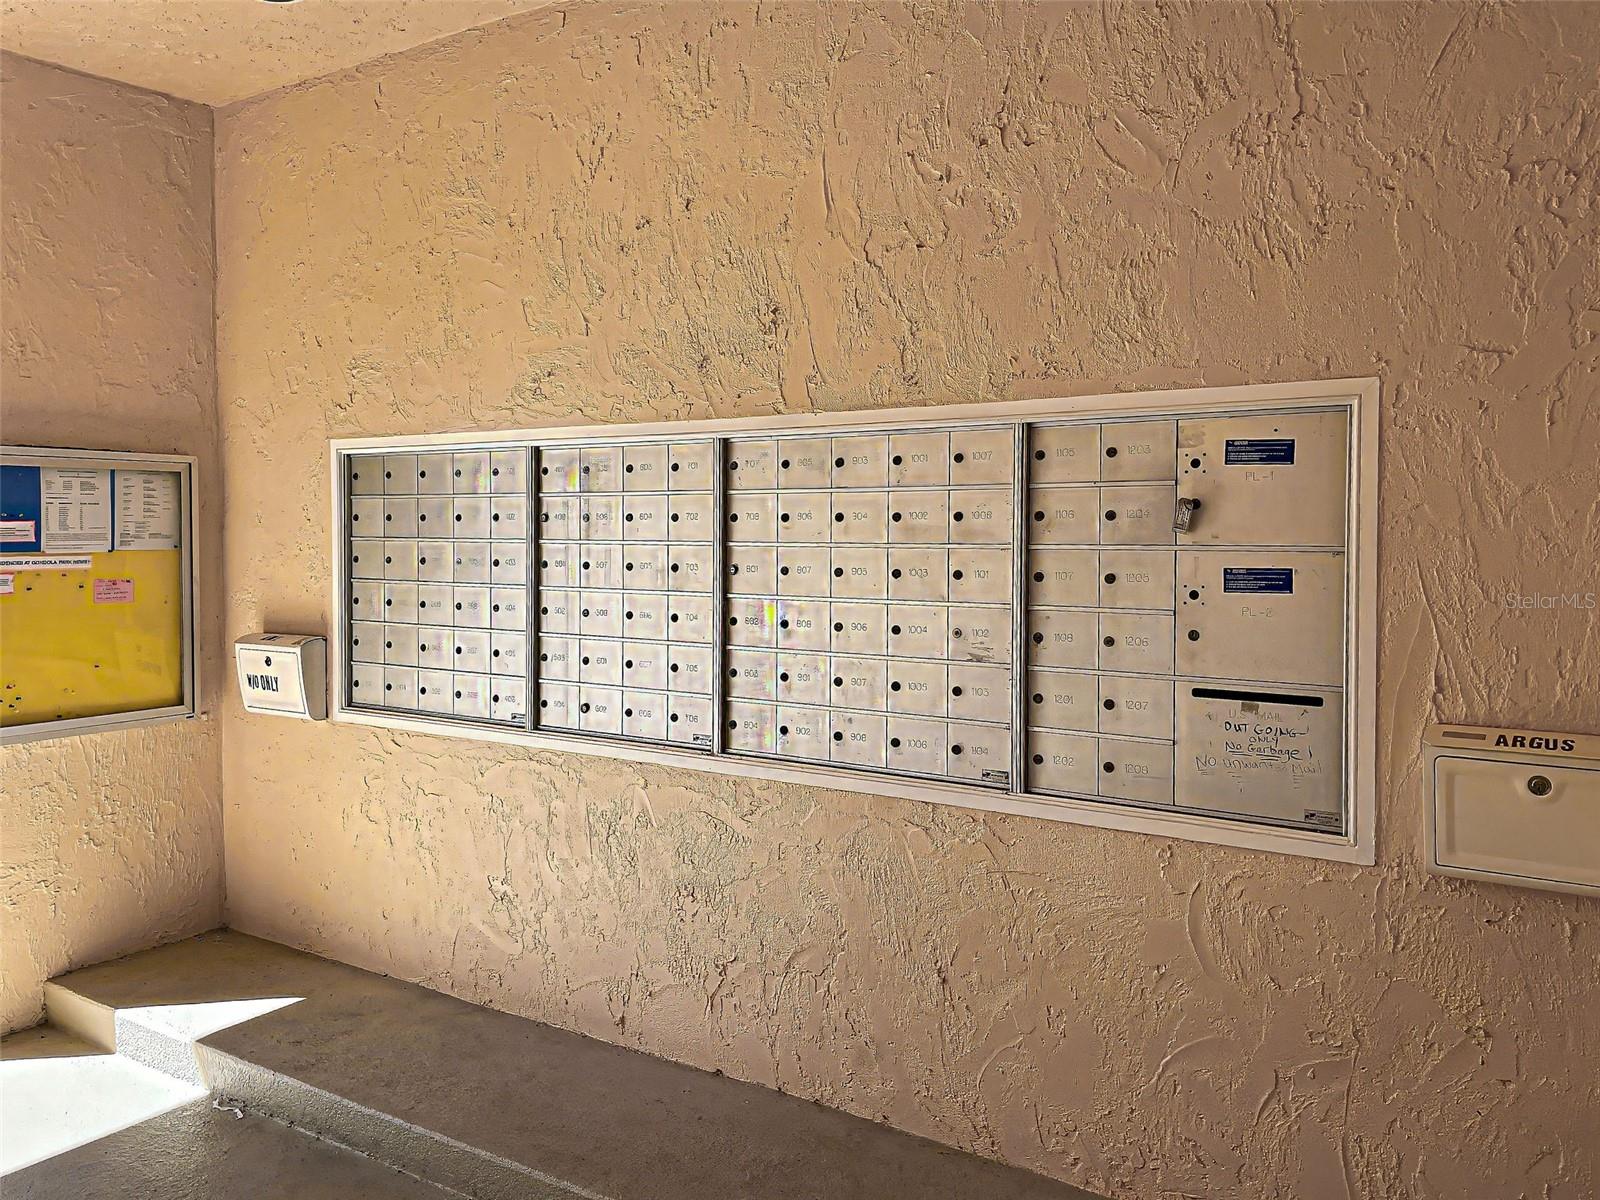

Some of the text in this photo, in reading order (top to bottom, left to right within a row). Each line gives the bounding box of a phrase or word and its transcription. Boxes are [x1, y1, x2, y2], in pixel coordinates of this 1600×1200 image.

[1056, 448, 1075, 457] 1105
[1128, 445, 1151, 454] 1203
[852, 456, 868, 464] 903
[911, 454, 928, 462] 1001
[972, 451, 992, 460] 1007
[1245, 471, 1275, 482] PL-1
[686, 512, 698, 520] 702
[745, 512, 760, 520] 708
[909, 512, 928, 520] 1002
[1055, 509, 1075, 519] 1106
[1126, 509, 1150, 518] 1204
[686, 563, 699, 572] 703
[796, 566, 812, 574] 807
[851, 567, 868, 576] 905
[909, 568, 928, 577] 1003
[974, 570, 989, 579] 1101
[1055, 571, 1073, 581] 1107
[1126, 573, 1150, 583] 1205
[1241, 606, 1273, 617] PL-2
[685, 614, 698, 622] 704
[797, 620, 812, 628] 808
[851, 622, 868, 631] 906
[908, 626, 928, 634] 1004
[972, 629, 989, 638] 1102
[1054, 632, 1073, 643] 1108
[1125, 636, 1149, 647] 1206
[685, 664, 698, 672] 705
[260, 674, 279, 692] ONLY
[851, 678, 867, 686] 907
[908, 682, 928, 691] 1005
[972, 687, 990, 696] 1103
[1054, 694, 1074, 705] 1201
[1125, 700, 1149, 711] 1207
[685, 714, 698, 722] 706
[744, 721, 758, 729] 804
[1225, 721, 1248, 732] OUT
[795, 727, 811, 736] 902
[908, 738, 928, 748] 1006
[1225, 741, 1241, 751] No
[1249, 736, 1278, 747] ONLY
[1495, 734, 1575, 752] ARGUS
[971, 746, 988, 755] 1104
[1053, 755, 1075, 766] 1202
[1125, 764, 1149, 774] 1208
